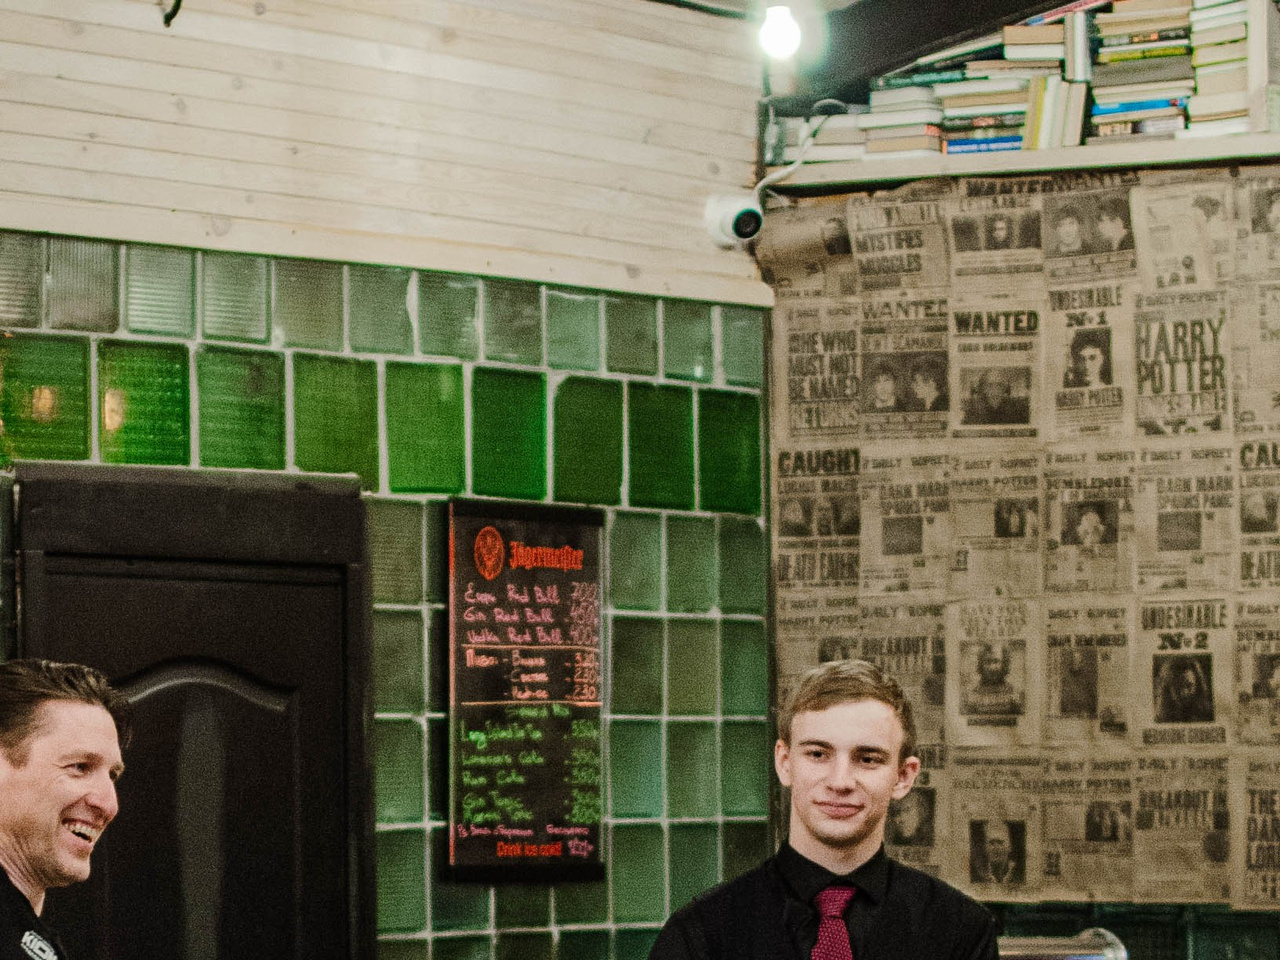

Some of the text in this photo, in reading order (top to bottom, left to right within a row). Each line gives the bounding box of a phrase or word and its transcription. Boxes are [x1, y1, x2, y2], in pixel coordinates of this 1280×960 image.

[953, 310, 1039, 333] WANTED
[1135, 311, 1226, 360] HARRY
[1136, 354, 1227, 394] POTTER
